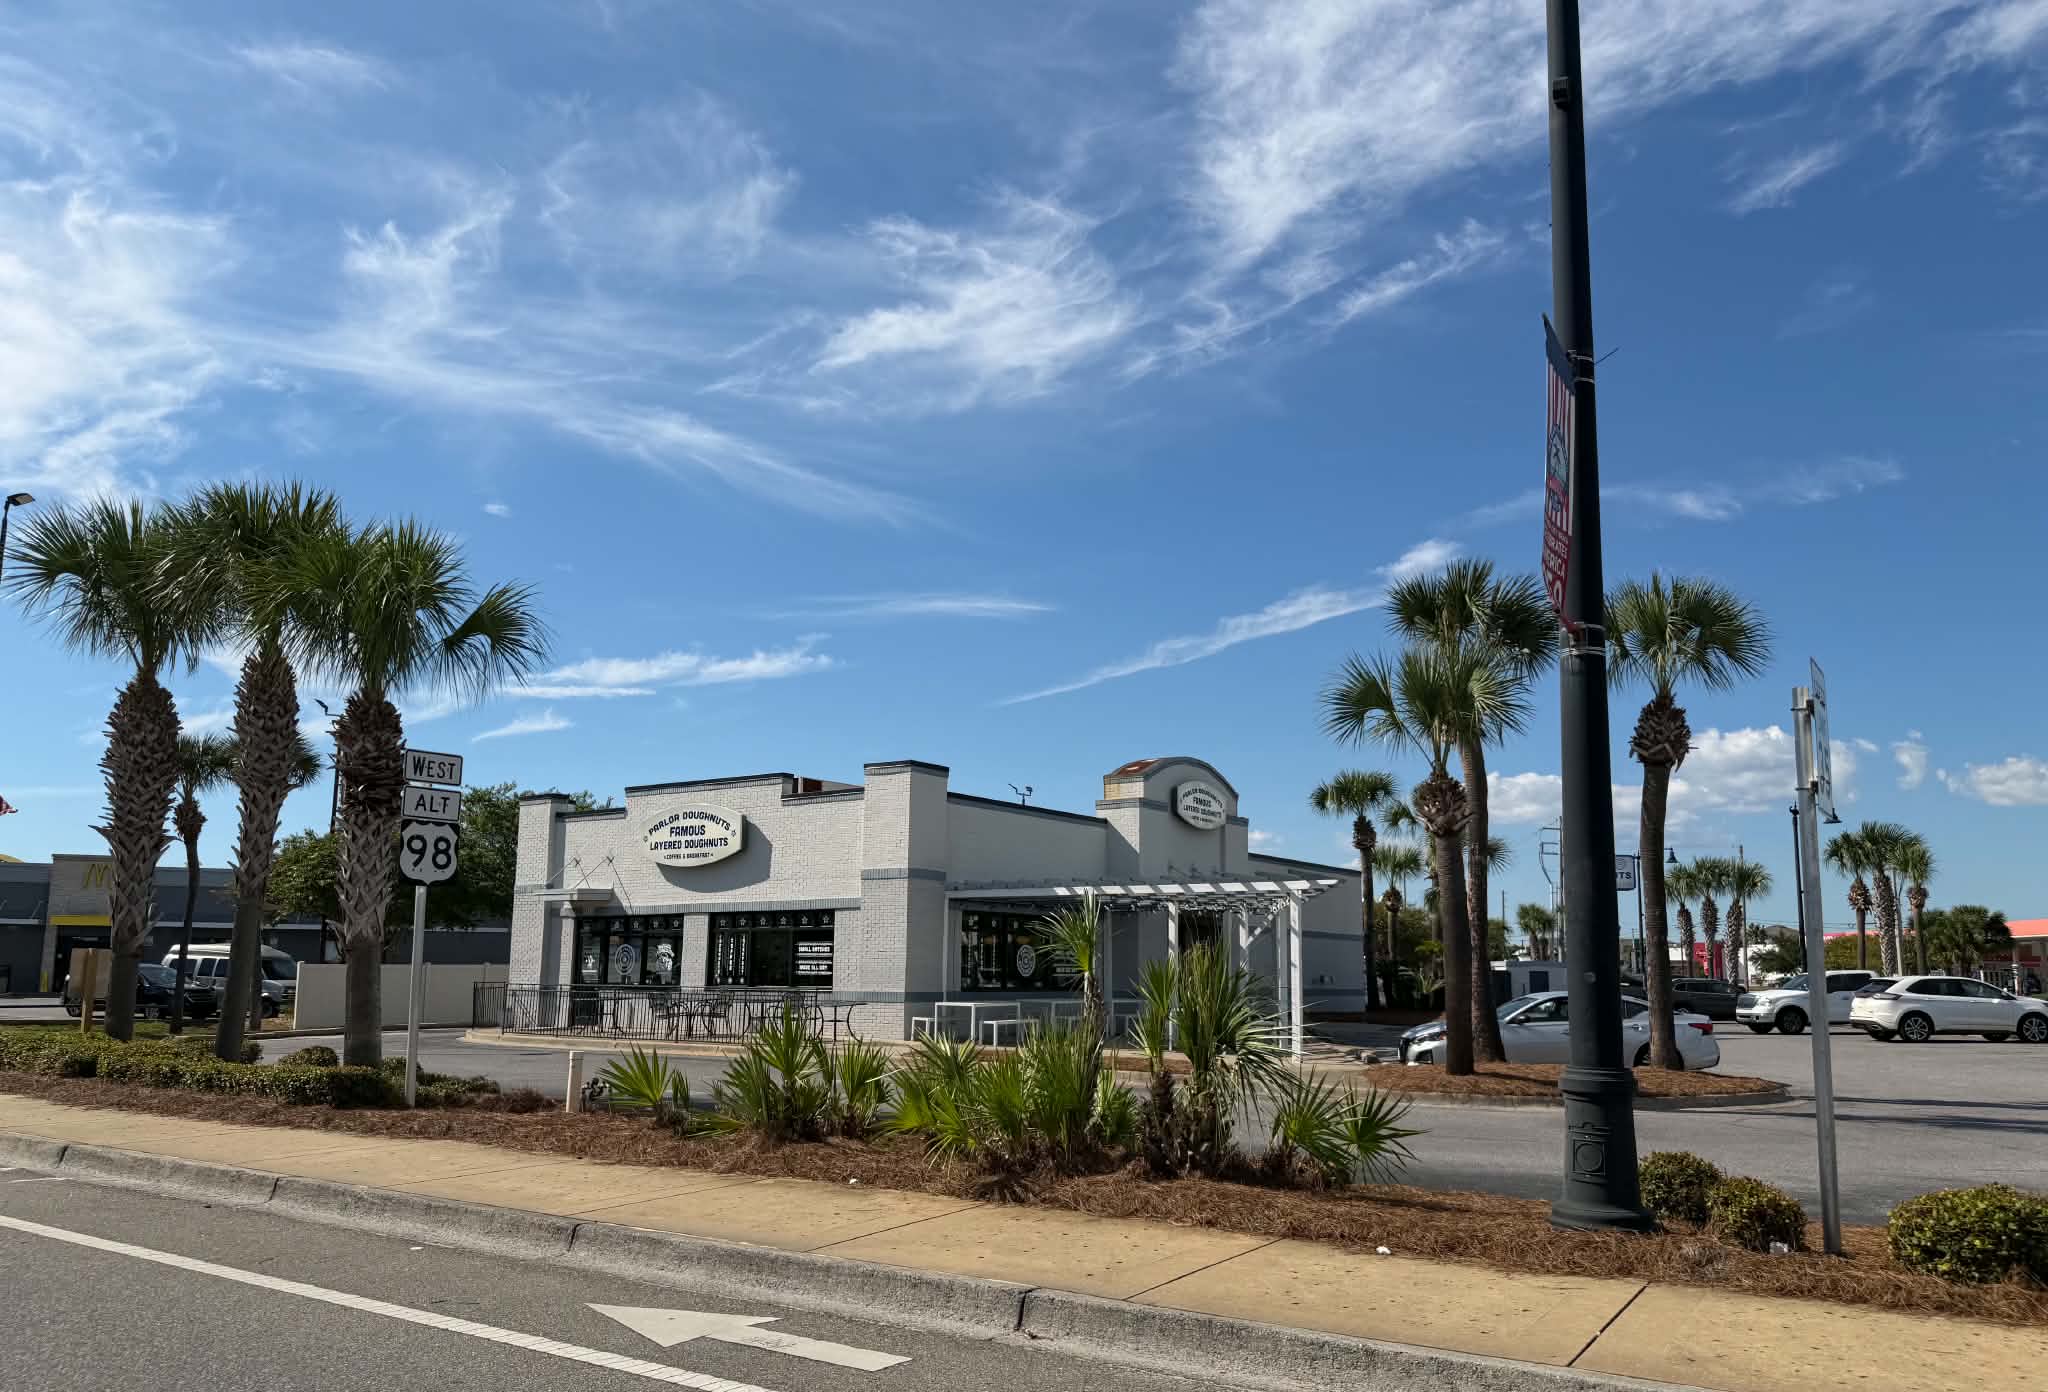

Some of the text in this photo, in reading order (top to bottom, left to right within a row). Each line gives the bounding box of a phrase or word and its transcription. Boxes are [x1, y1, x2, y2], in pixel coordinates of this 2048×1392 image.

[413, 755, 456, 780] WEST
[415, 793, 450, 814] ALT
[648, 811, 731, 836] PARLOR DOUGHNUTS
[669, 825, 706, 838] FAMOUS
[406, 834, 452, 870] 98
[649, 837, 729, 851] LAYERED DOUGHNUTS
